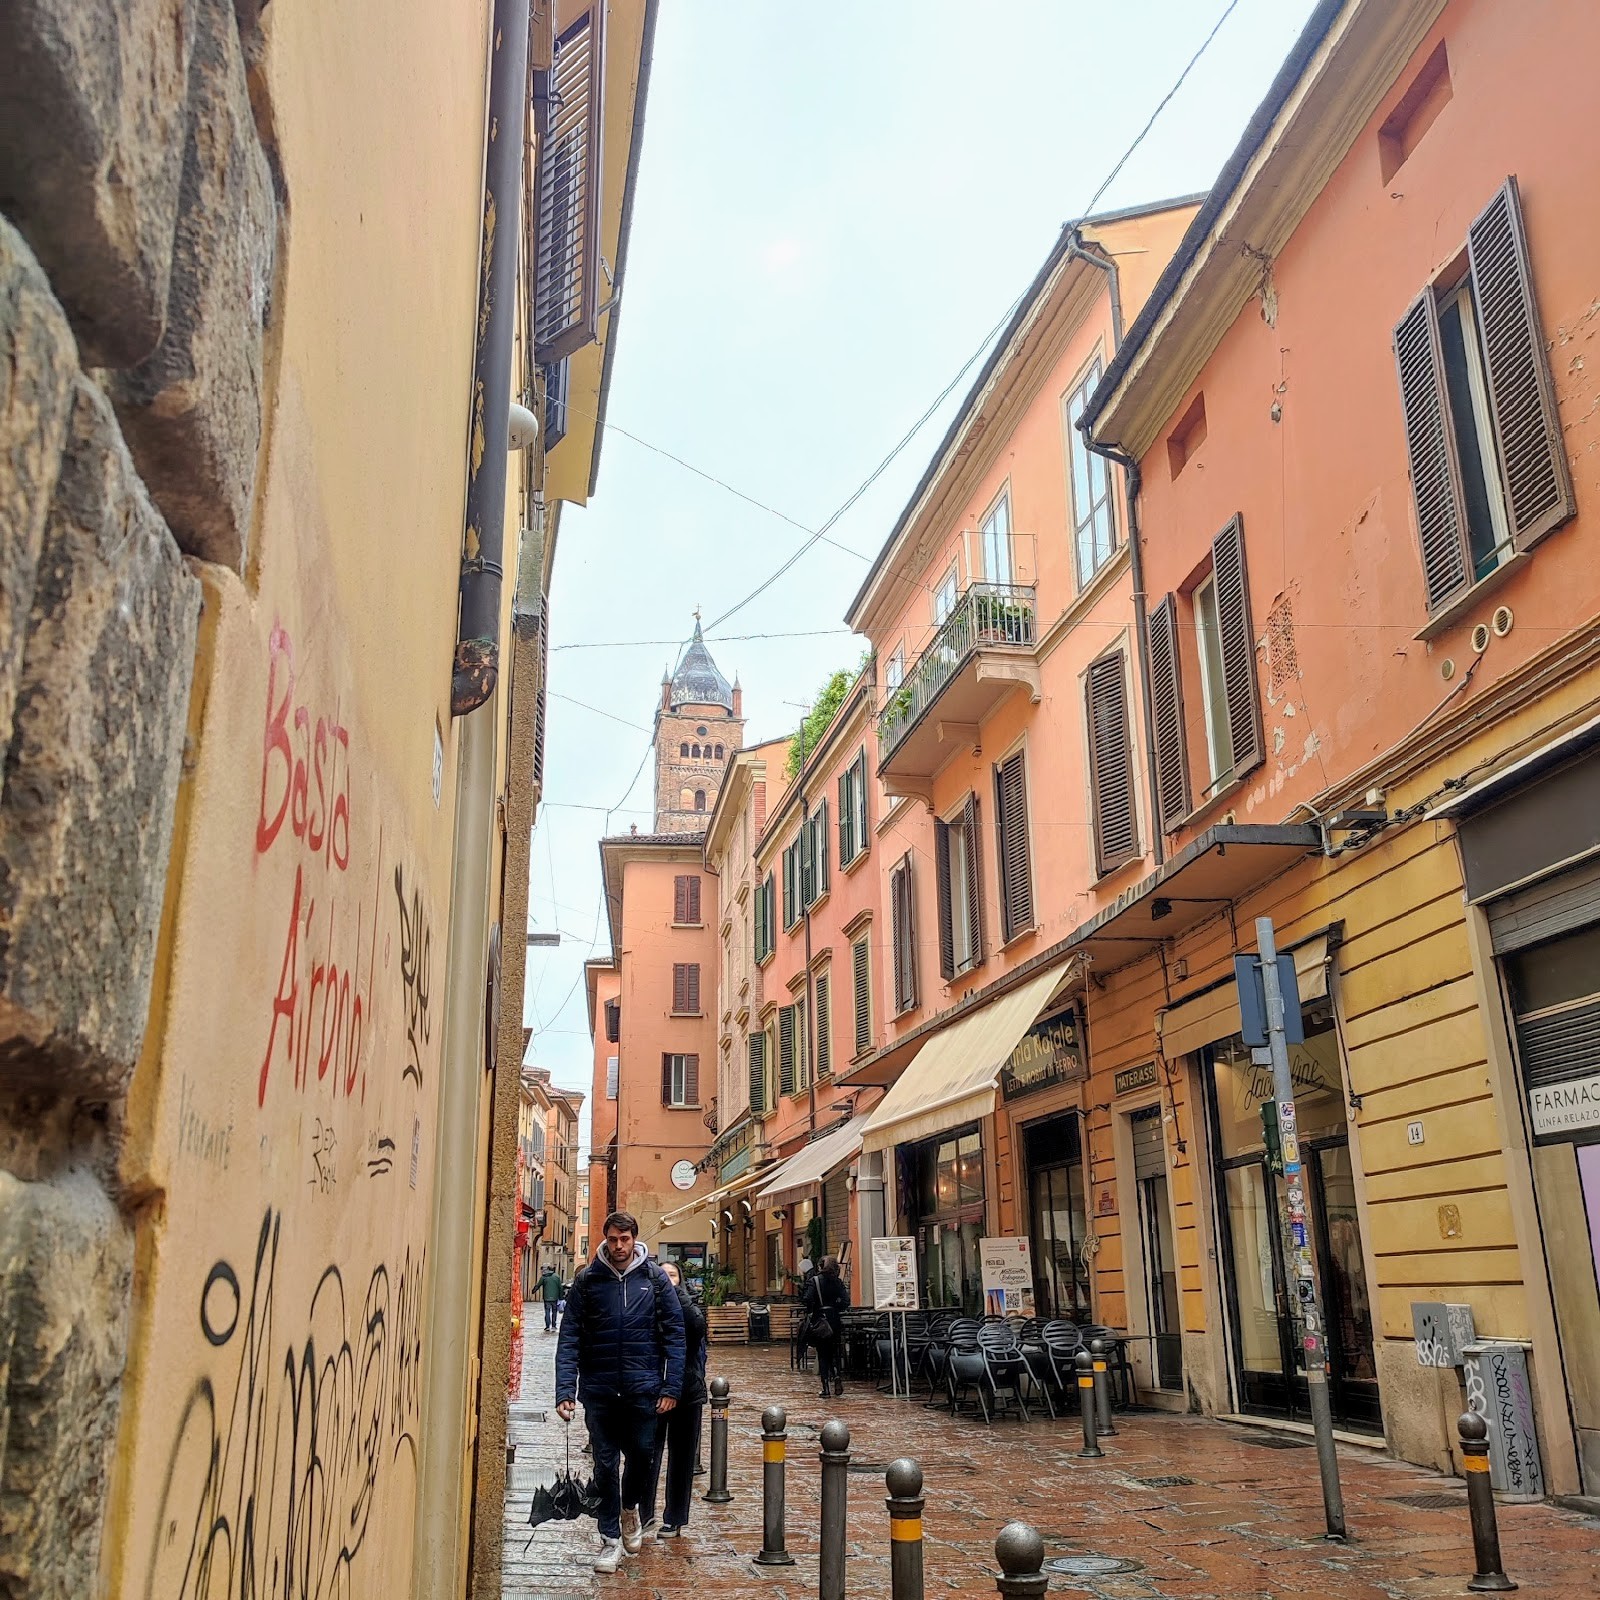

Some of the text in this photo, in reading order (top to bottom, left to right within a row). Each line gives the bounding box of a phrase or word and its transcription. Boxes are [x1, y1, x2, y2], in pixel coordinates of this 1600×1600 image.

[255, 622, 350, 872] Basta
[1032, 1020, 1074, 1058] Natale
[1056, 1054, 1078, 1075] FERRO
[1116, 1065, 1156, 1091] MATERASSI
[1411, 1127, 1420, 1140] 14
